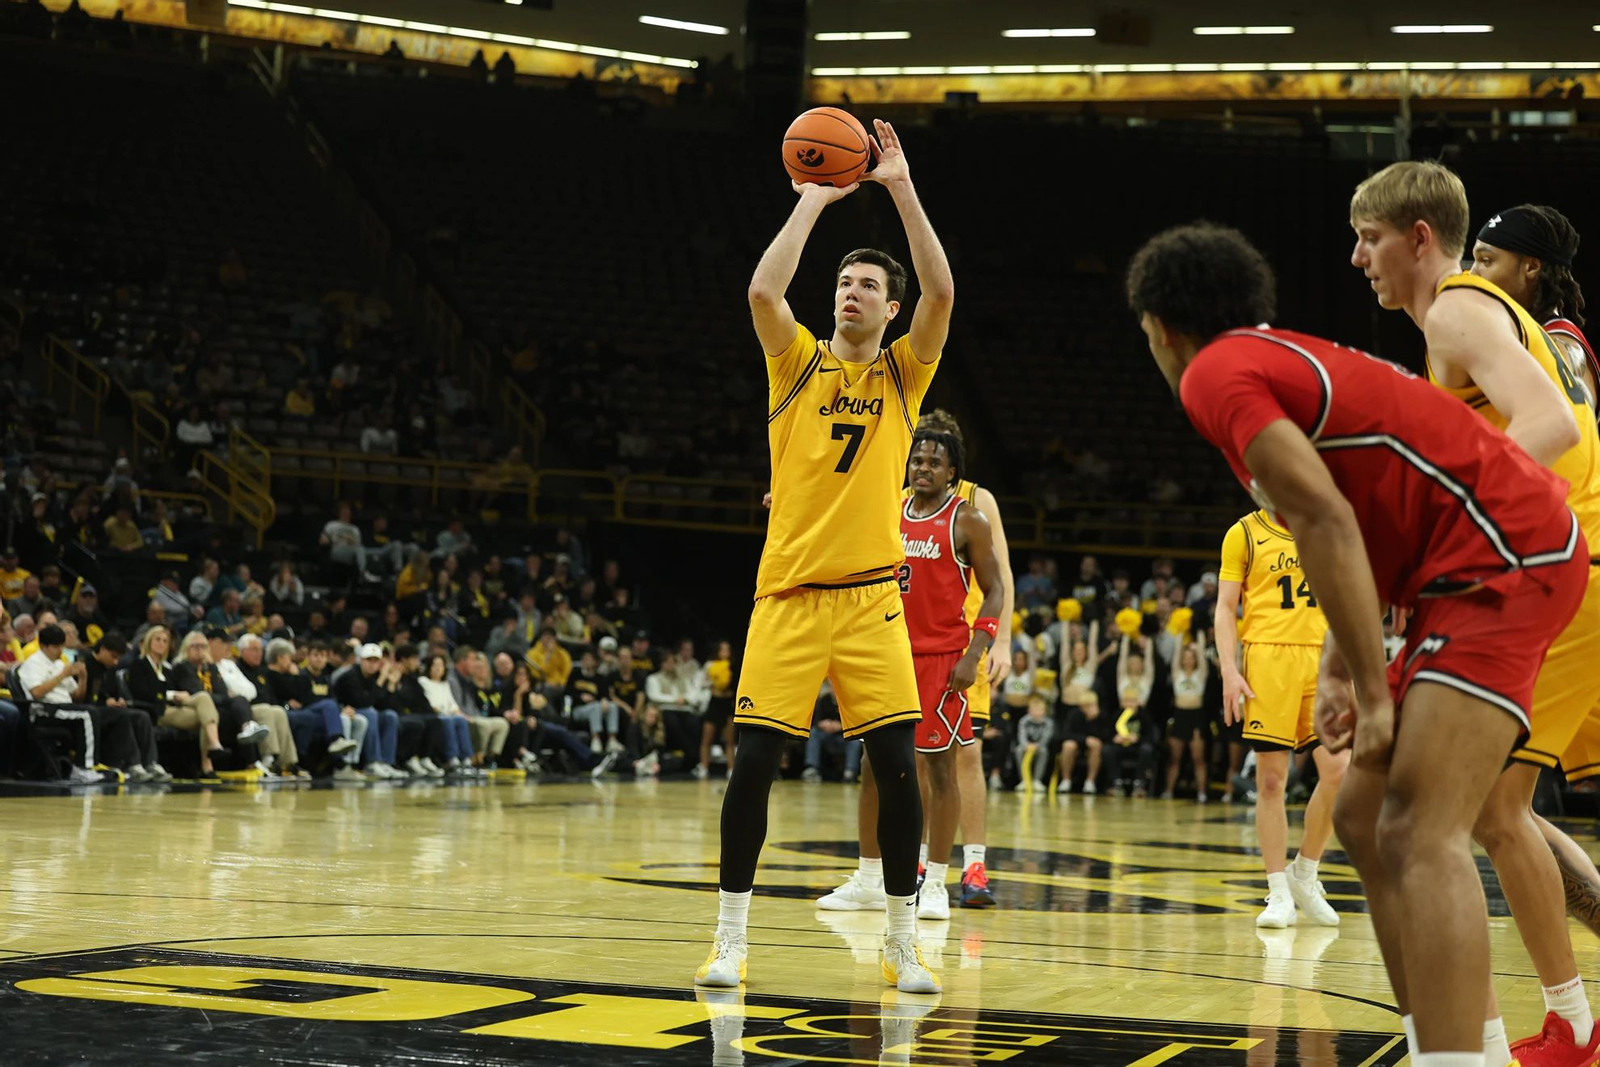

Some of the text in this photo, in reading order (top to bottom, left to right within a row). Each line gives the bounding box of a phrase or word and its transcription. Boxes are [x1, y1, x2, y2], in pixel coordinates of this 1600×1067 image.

[819, 388, 883, 416] Iowa
[831, 422, 866, 474] 7
[900, 533, 942, 560] hawks
[1277, 575, 1317, 609] 14
